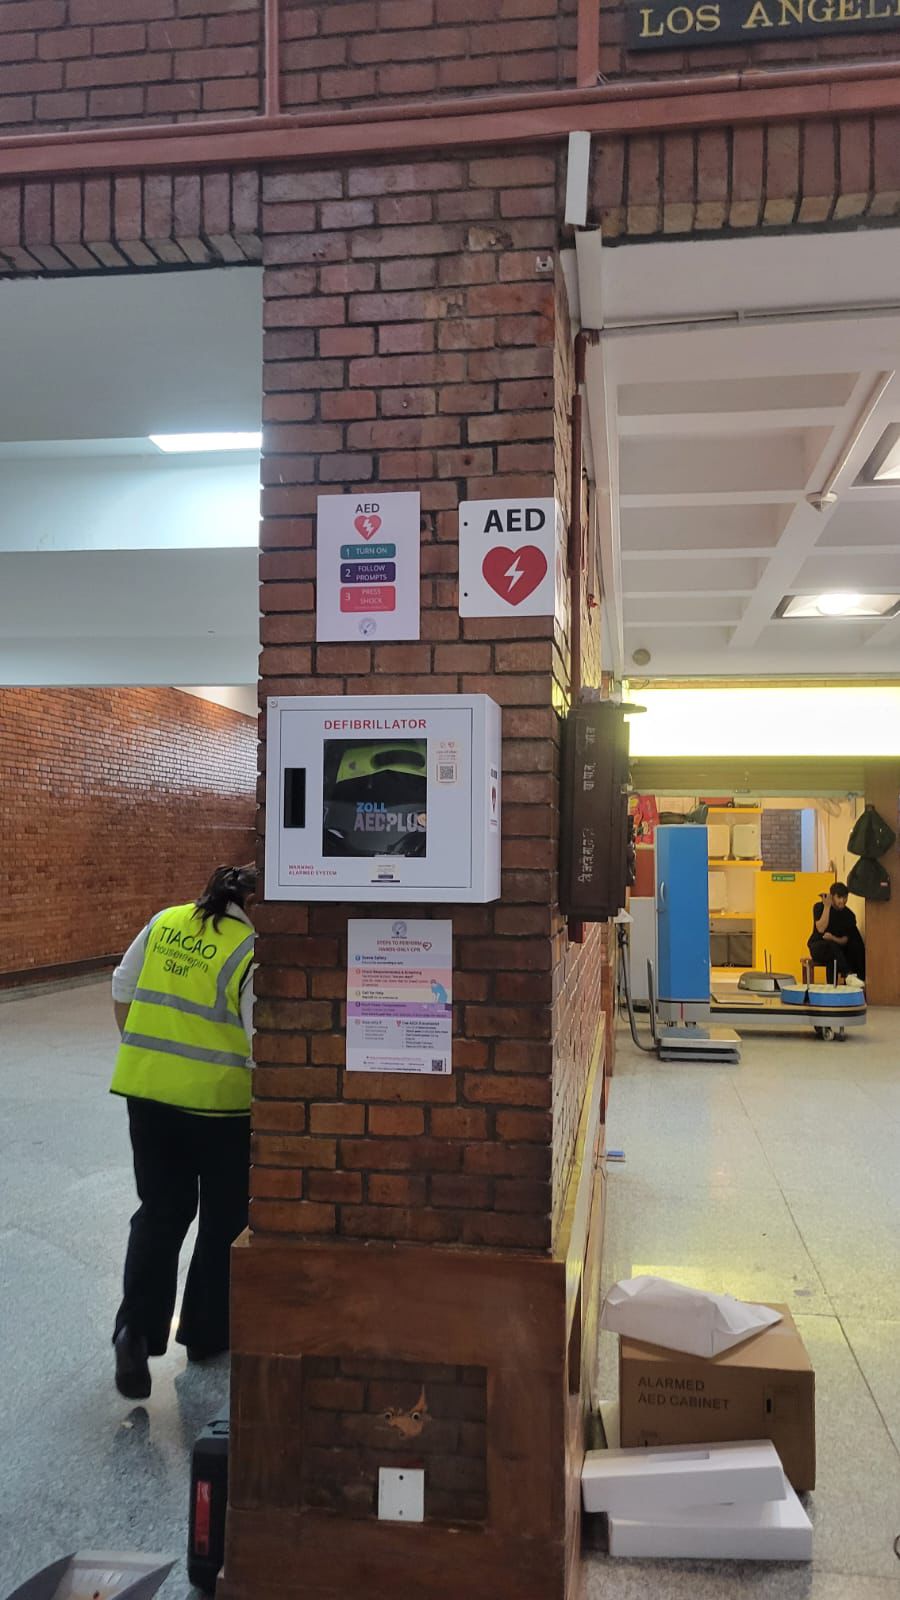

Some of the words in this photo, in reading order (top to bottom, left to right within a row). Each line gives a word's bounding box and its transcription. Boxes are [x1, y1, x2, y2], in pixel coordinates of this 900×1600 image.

[639, 4, 721, 38] LOS
[741, 0, 900, 29] ANGEL
[355, 503, 380, 514] AED
[483, 507, 546, 534] AED
[345, 547, 350, 558] 1
[356, 547, 375, 555] TURN
[376, 546, 388, 554] ON
[345, 568, 351, 578] 2
[358, 564, 386, 572] FOLLOW
[356, 573, 388, 581] PROMPTS
[345, 591, 351, 601] 3
[360, 597, 383, 605] SHOCK
[323, 718, 427, 730] DEFIBRILLATOR
[355, 801, 388, 813] ZOLL
[160, 926, 217, 960] TIACAO
[163, 958, 189, 978] Staff
[638, 1376, 705, 1392] ALARMED
[638, 1391, 667, 1407] AED
[669, 1393, 729, 1410] CABINET
